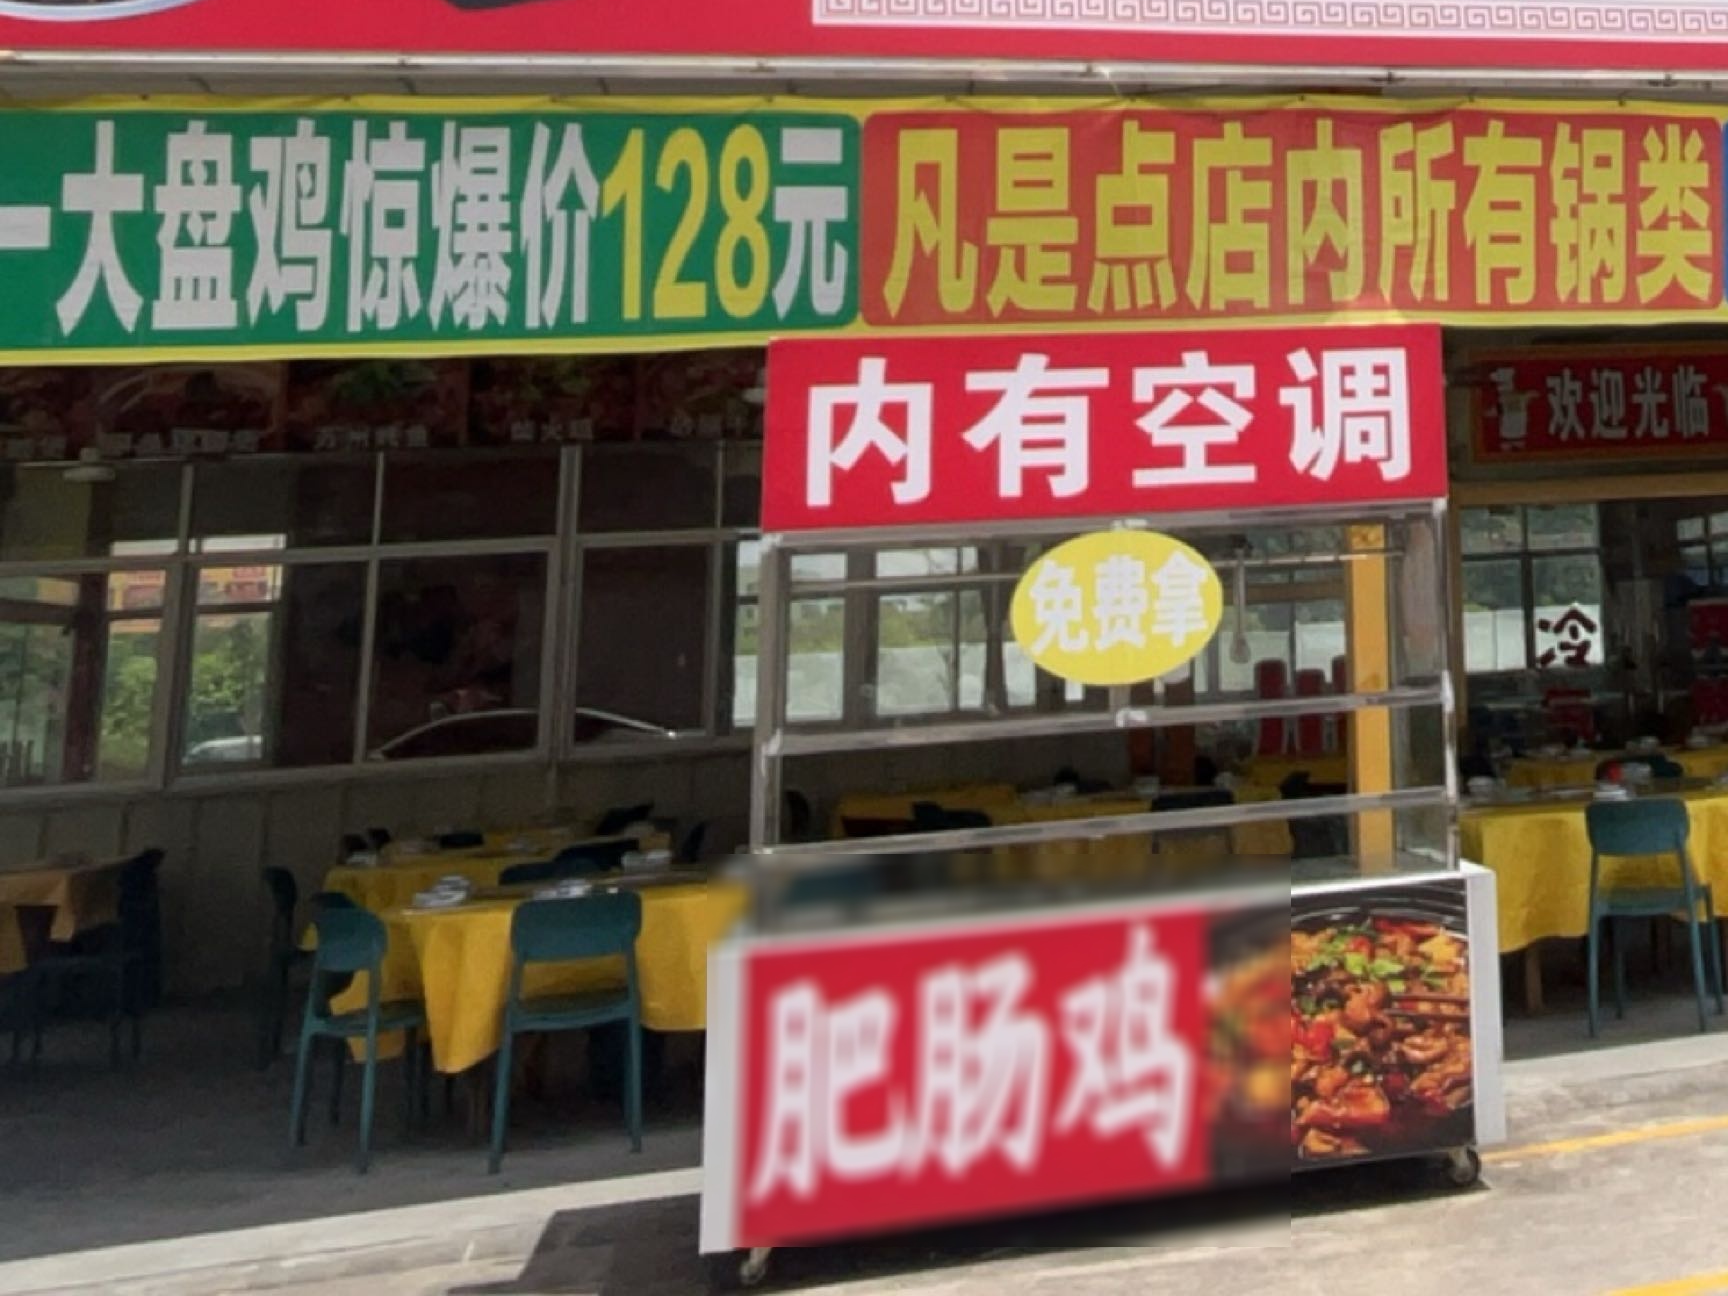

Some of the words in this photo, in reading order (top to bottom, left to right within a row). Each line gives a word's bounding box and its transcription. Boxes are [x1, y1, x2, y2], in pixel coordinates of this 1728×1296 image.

[883, 118, 1712, 317] 凡是点店内所有锅类
[805, 346, 1412, 507] 内有空调
[1545, 364, 1710, 442] 欢迎光临
[1028, 553, 1209, 655] 免费拿
[752, 916, 1190, 1206] 肥肠鸡
